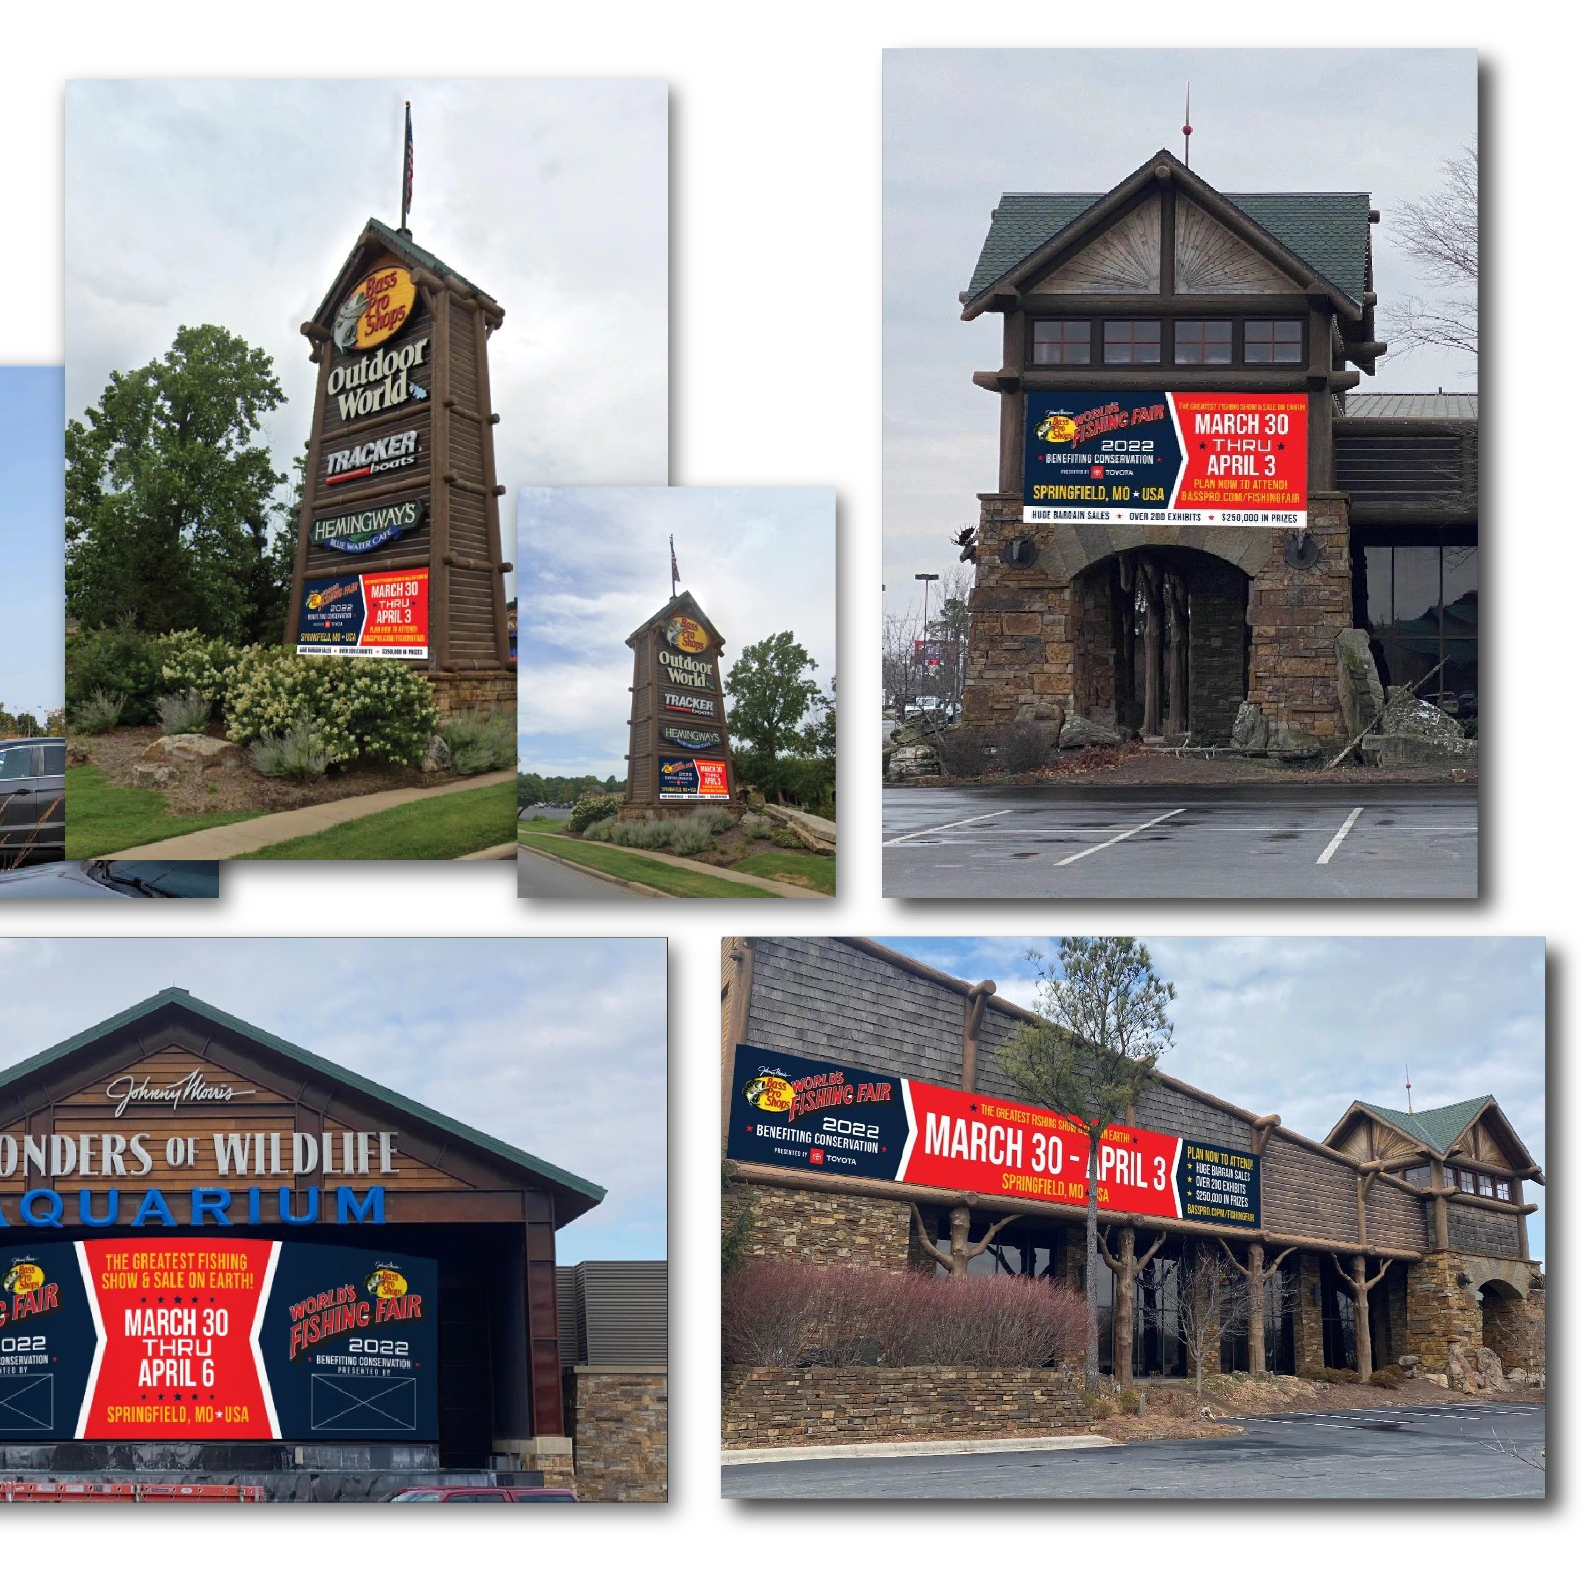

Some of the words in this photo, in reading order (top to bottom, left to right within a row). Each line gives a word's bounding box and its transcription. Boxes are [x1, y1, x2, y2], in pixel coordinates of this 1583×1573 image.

[365, 271, 397, 296] Bass
[366, 294, 390, 319] Pro
[364, 305, 405, 338] Shops
[327, 338, 427, 396] Outdoor
[338, 370, 408, 421] World
[1195, 414, 1259, 434] MARCH
[1265, 414, 1289, 435] 30
[327, 431, 417, 474] TRACKER
[1101, 440, 1153, 452] 2022
[1213, 439, 1271, 452] THRU
[370, 456, 415, 474] boats
[1207, 455, 1259, 476] APRIL
[1265, 455, 1275, 476] 3
[1033, 485, 1109, 502] SPRINGFIELD,
[1113, 486, 1130, 500] MO
[1142, 488, 1165, 500] USA
[315, 502, 415, 541] HEMINGWAY'S
[347, 540, 371, 550] WATER
[371, 582, 403, 598] MARCH
[405, 582, 418, 596] 30
[379, 598, 409, 609] THRU
[376, 610, 403, 624] APRIL
[405, 610, 411, 624] 3
[659, 651, 712, 675] Outdoor
[667, 668, 705, 686] World
[665, 694, 713, 711] TRACKER
[665, 728, 719, 742] HEMINGWAY'S
[106, 1075, 179, 1117] Johnny
[168, 1067, 256, 1101] Morris
[757, 1124, 811, 1144] BENEFITING
[815, 1133, 879, 1154] CONSERVATION
[823, 1117, 879, 1140] 2022
[166, 1137, 199, 1168] OF
[213, 1132, 399, 1176] WILDLIFE
[827, 1155, 857, 1166] TOYOTA
[924, 1111, 1023, 1168] MARCH
[1031, 1132, 1063, 1174] 30
[1153, 1156, 1166, 1191] 3
[105, 1253, 129, 1271] THE
[133, 1252, 195, 1270] GREATEST
[198, 1252, 247, 1271] FISHING
[101, 1272, 137, 1289] SHOW
[141, 1273, 150, 1288] &
[153, 1272, 185, 1288] SALE
[189, 1272, 205, 1288] ON
[210, 1272, 254, 1290] EARTH!
[125, 1308, 197, 1336] MARCH
[202, 1308, 228, 1336] 30
[142, 1339, 212, 1356] THRU
[138, 1358, 197, 1387] APRIL
[202, 1358, 215, 1387] 6
